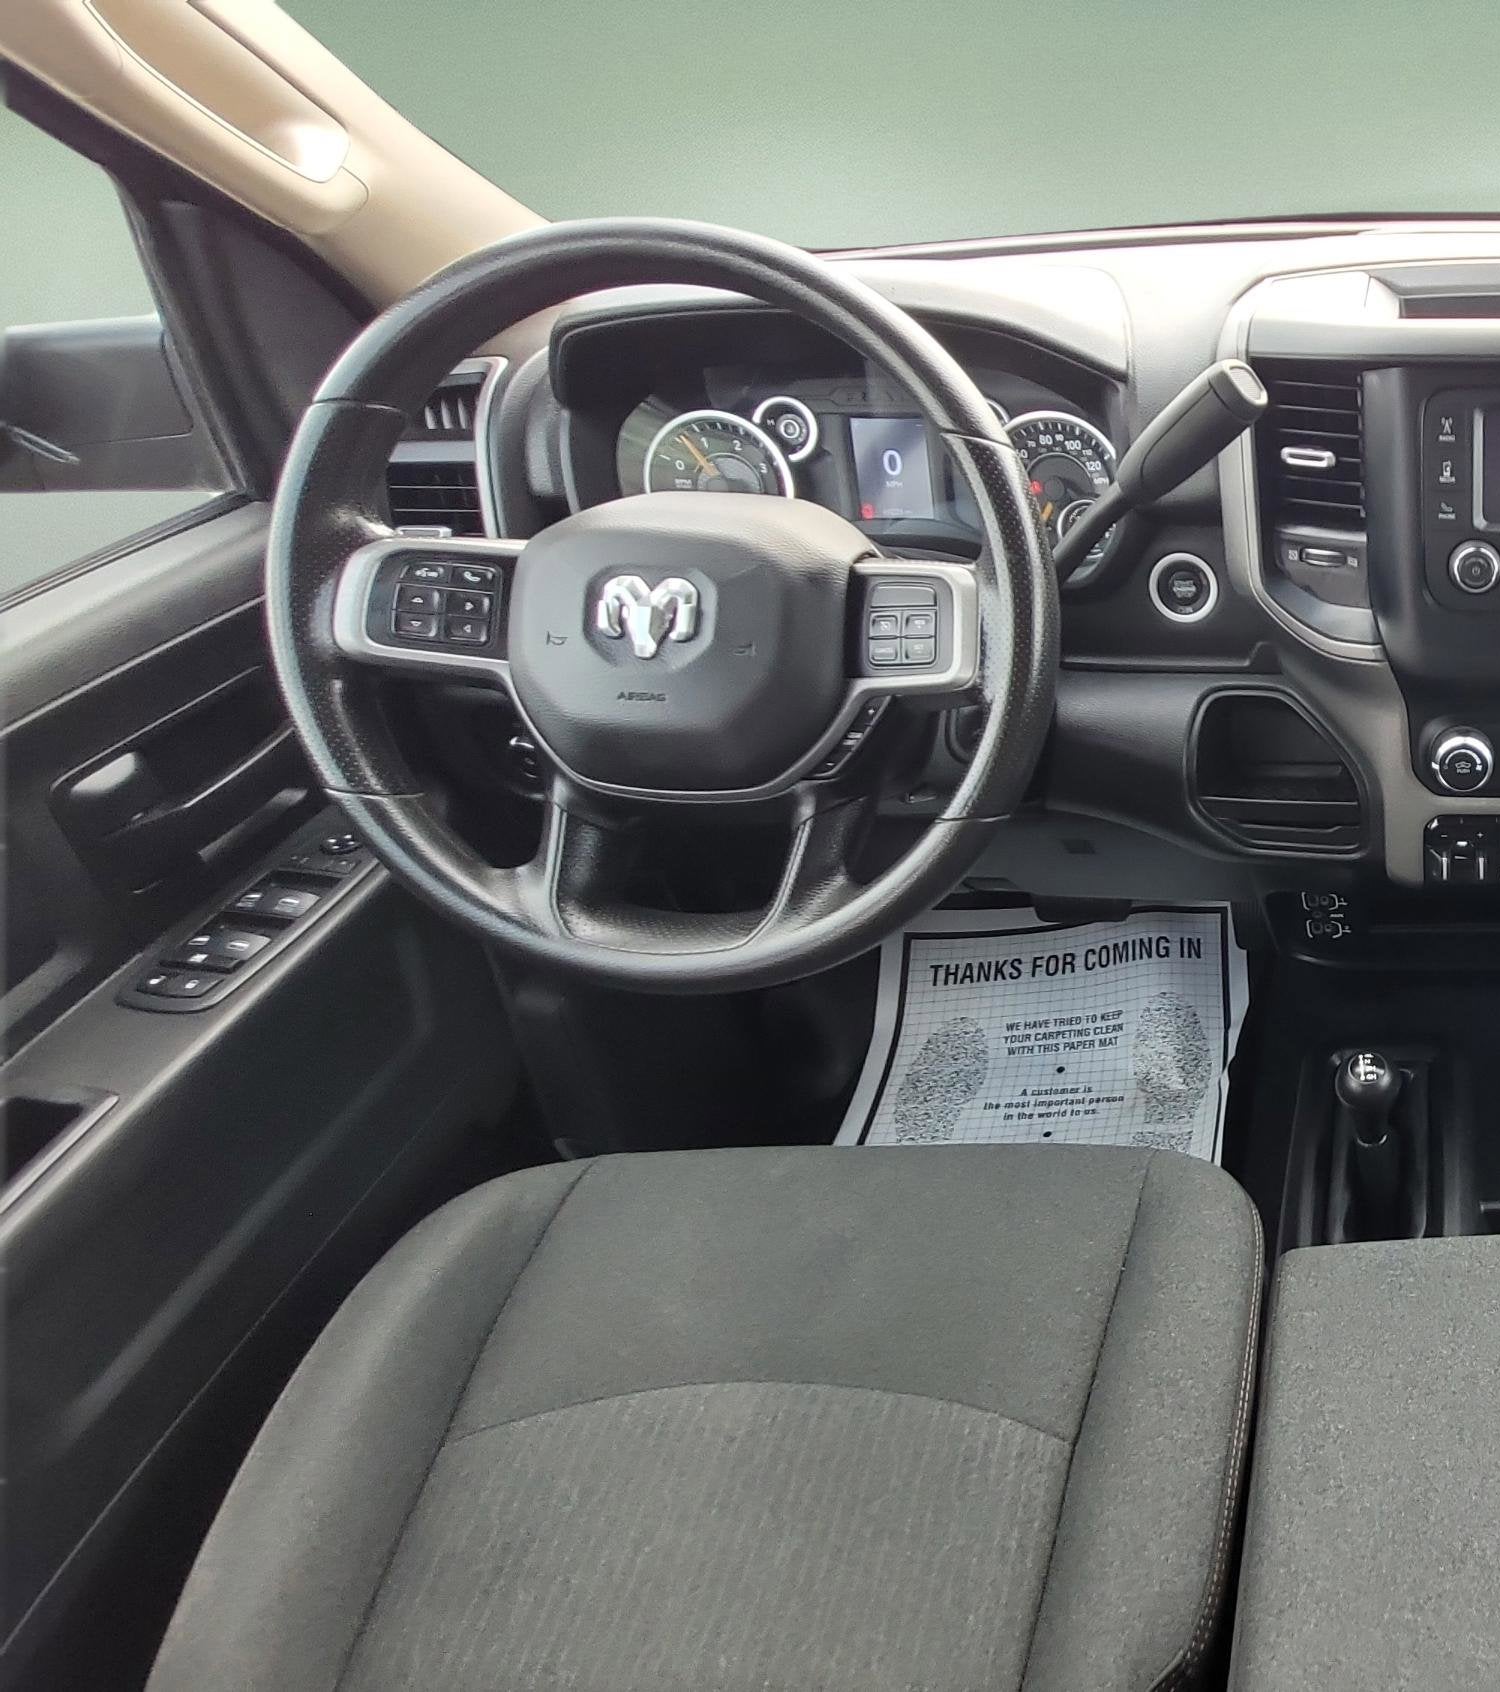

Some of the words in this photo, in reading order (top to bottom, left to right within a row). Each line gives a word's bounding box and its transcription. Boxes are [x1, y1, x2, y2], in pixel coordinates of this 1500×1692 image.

[732, 440, 743, 451] 2
[1038, 434, 1053, 446] 80
[1064, 440, 1081, 451] 100
[675, 459, 685, 471] 0
[883, 449, 903, 475] 0
[1085, 461, 1101, 471] 120
[759, 463, 769, 474] 3
[929, 957, 1022, 986] THANKS
[1031, 952, 1076, 978] FOR
[1084, 936, 1171, 971] COMING
[1179, 937, 1202, 959] IN
[1005, 1022, 1022, 1032] WE
[1023, 1019, 1052, 1030] HAVE
[1053, 1016, 1082, 1027] TRIED
[1085, 1014, 1098, 1024] TO
[1100, 1010, 1124, 1022] KEEP
[1003, 1034, 1031, 1044] YOUR
[1034, 1028, 1091, 1042] CARPETING
[1093, 1023, 1124, 1036] CLEAN
[1007, 1045, 1034, 1056] WITH
[1037, 1043, 1060, 1054] THIS
[1062, 1040, 1095, 1051] PAPER
[1098, 1036, 1118, 1048] MAT
[1020, 1088, 1028, 1096] A
[1030, 1086, 1080, 1096] customer
[1083, 1085, 1093, 1094] is
[983, 1101, 1000, 1110] the
[1004, 1100, 1031, 1109] most
[1034, 1097, 1085, 1109] important
[1088, 1095, 1125, 1105] person
[1003, 1112, 1014, 1121] in
[1017, 1111, 1034, 1120] the
[1037, 1108, 1067, 1119] world
[1069, 1109, 1081, 1117] to
